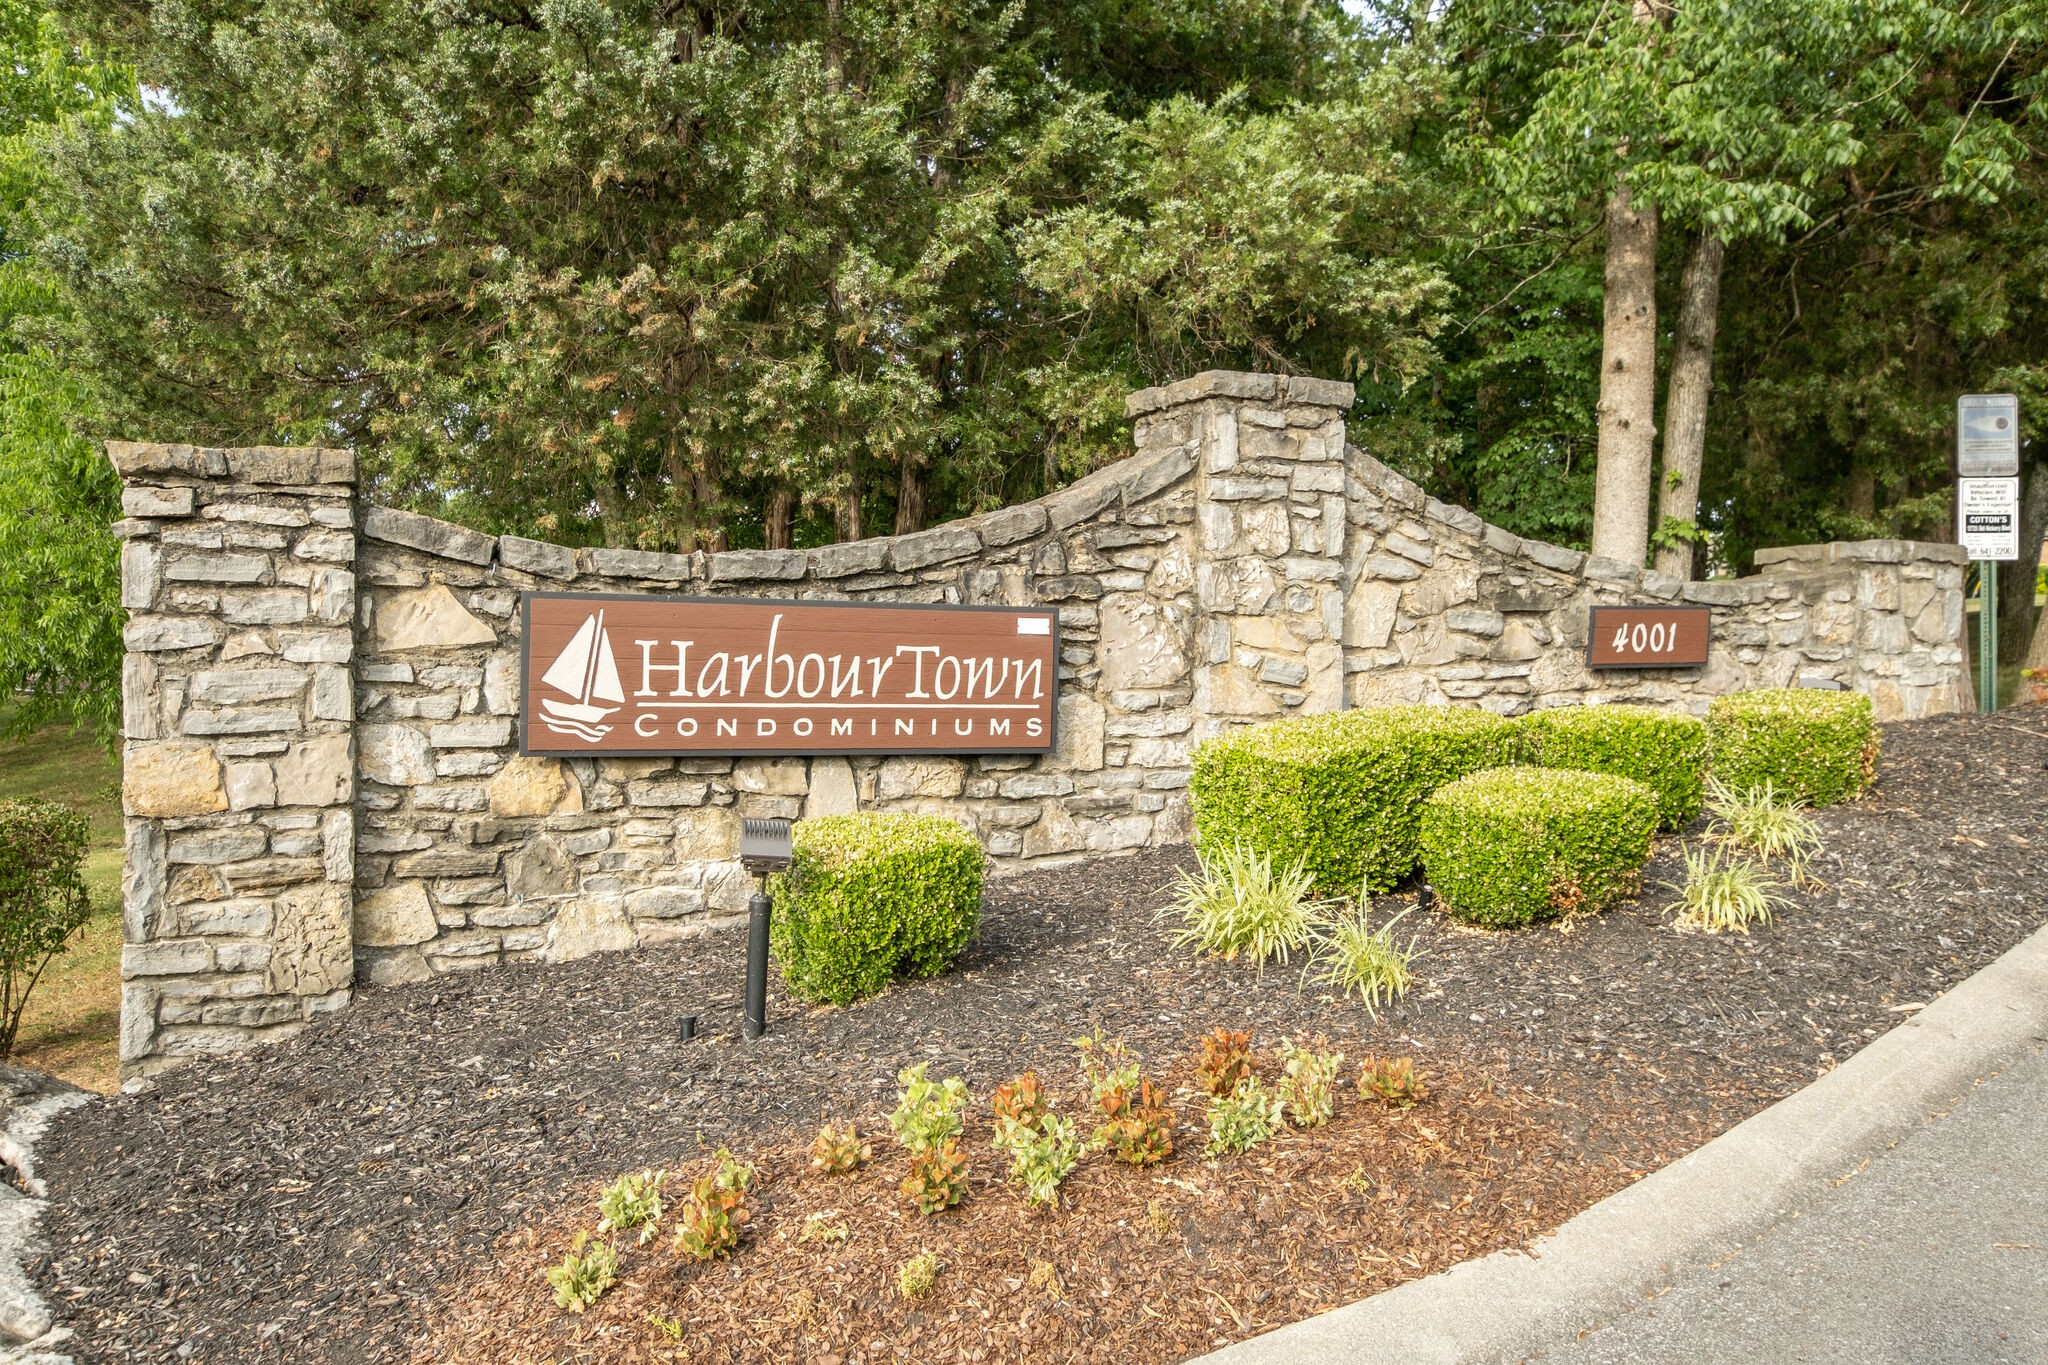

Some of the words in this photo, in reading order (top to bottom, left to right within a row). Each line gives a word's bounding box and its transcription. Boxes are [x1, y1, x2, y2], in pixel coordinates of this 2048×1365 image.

[1612, 622, 1677, 653] 4001
[634, 614, 892, 698] Harbour
[896, 645, 1044, 700] Town
[634, 713, 1043, 737] CONDOMINIUMS
